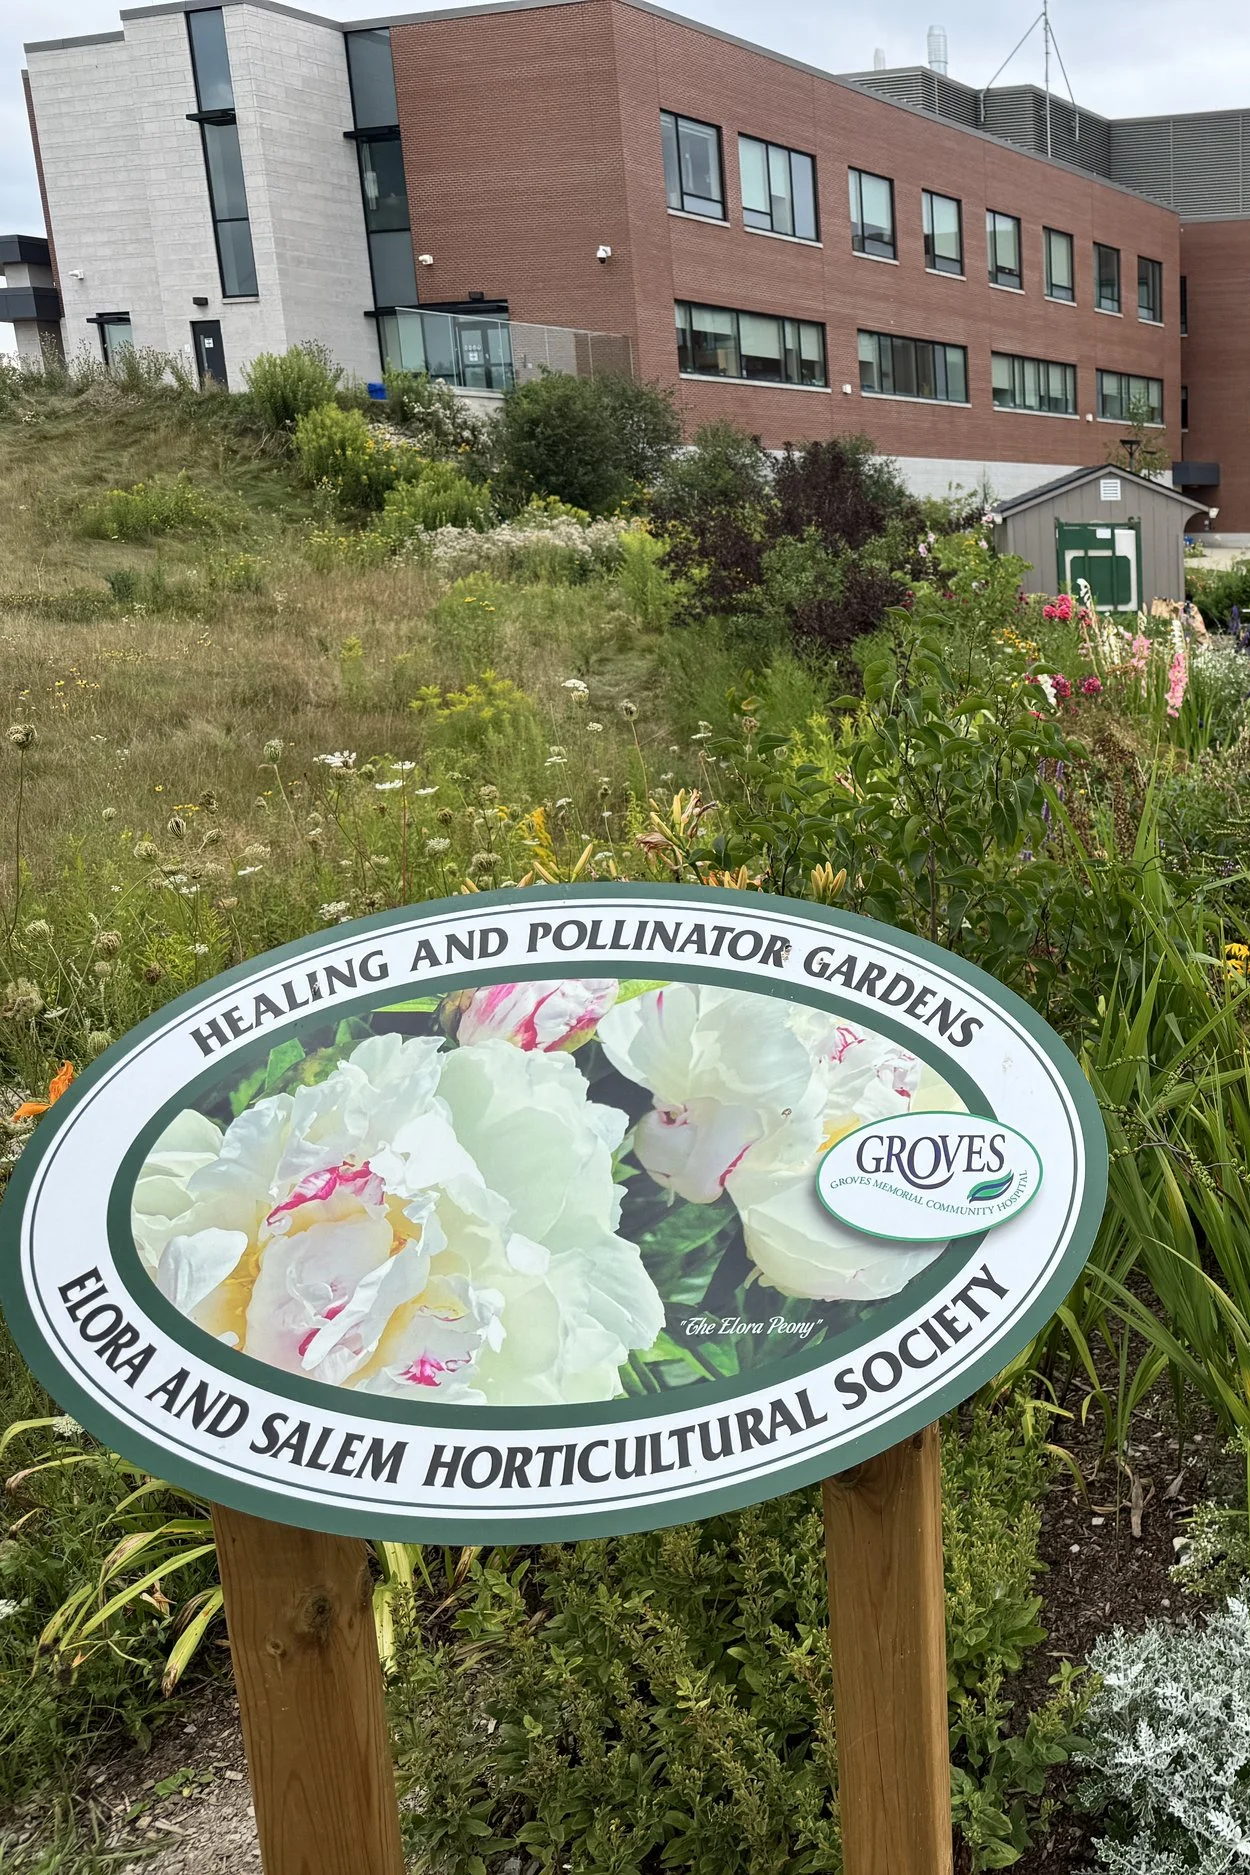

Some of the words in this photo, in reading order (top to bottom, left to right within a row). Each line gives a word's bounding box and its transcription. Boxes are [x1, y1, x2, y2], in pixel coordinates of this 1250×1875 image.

[188, 949, 389, 1058] HEALING
[410, 927, 508, 971] AND
[526, 919, 790, 968] POLLINATOR
[803, 945, 984, 1048] GARDENS
[856, 1134, 1006, 1190] GROVES
[830, 1175, 872, 1189] GROVES
[872, 1180, 924, 1205] MEMORIAL
[926, 1199, 994, 1216] COMMUNITY
[997, 1169, 1028, 1212] HOSPITAL
[680, 1317, 715, 1336] "The
[718, 1317, 763, 1335] Elora
[767, 1316, 824, 1339] Peony"
[58, 1266, 156, 1388] ELORA
[145, 1368, 250, 1438] AND
[249, 1412, 408, 1484] SALEM
[422, 1388, 828, 1489] HORTICULTURAL
[834, 1263, 1010, 1411] SOCIETY
